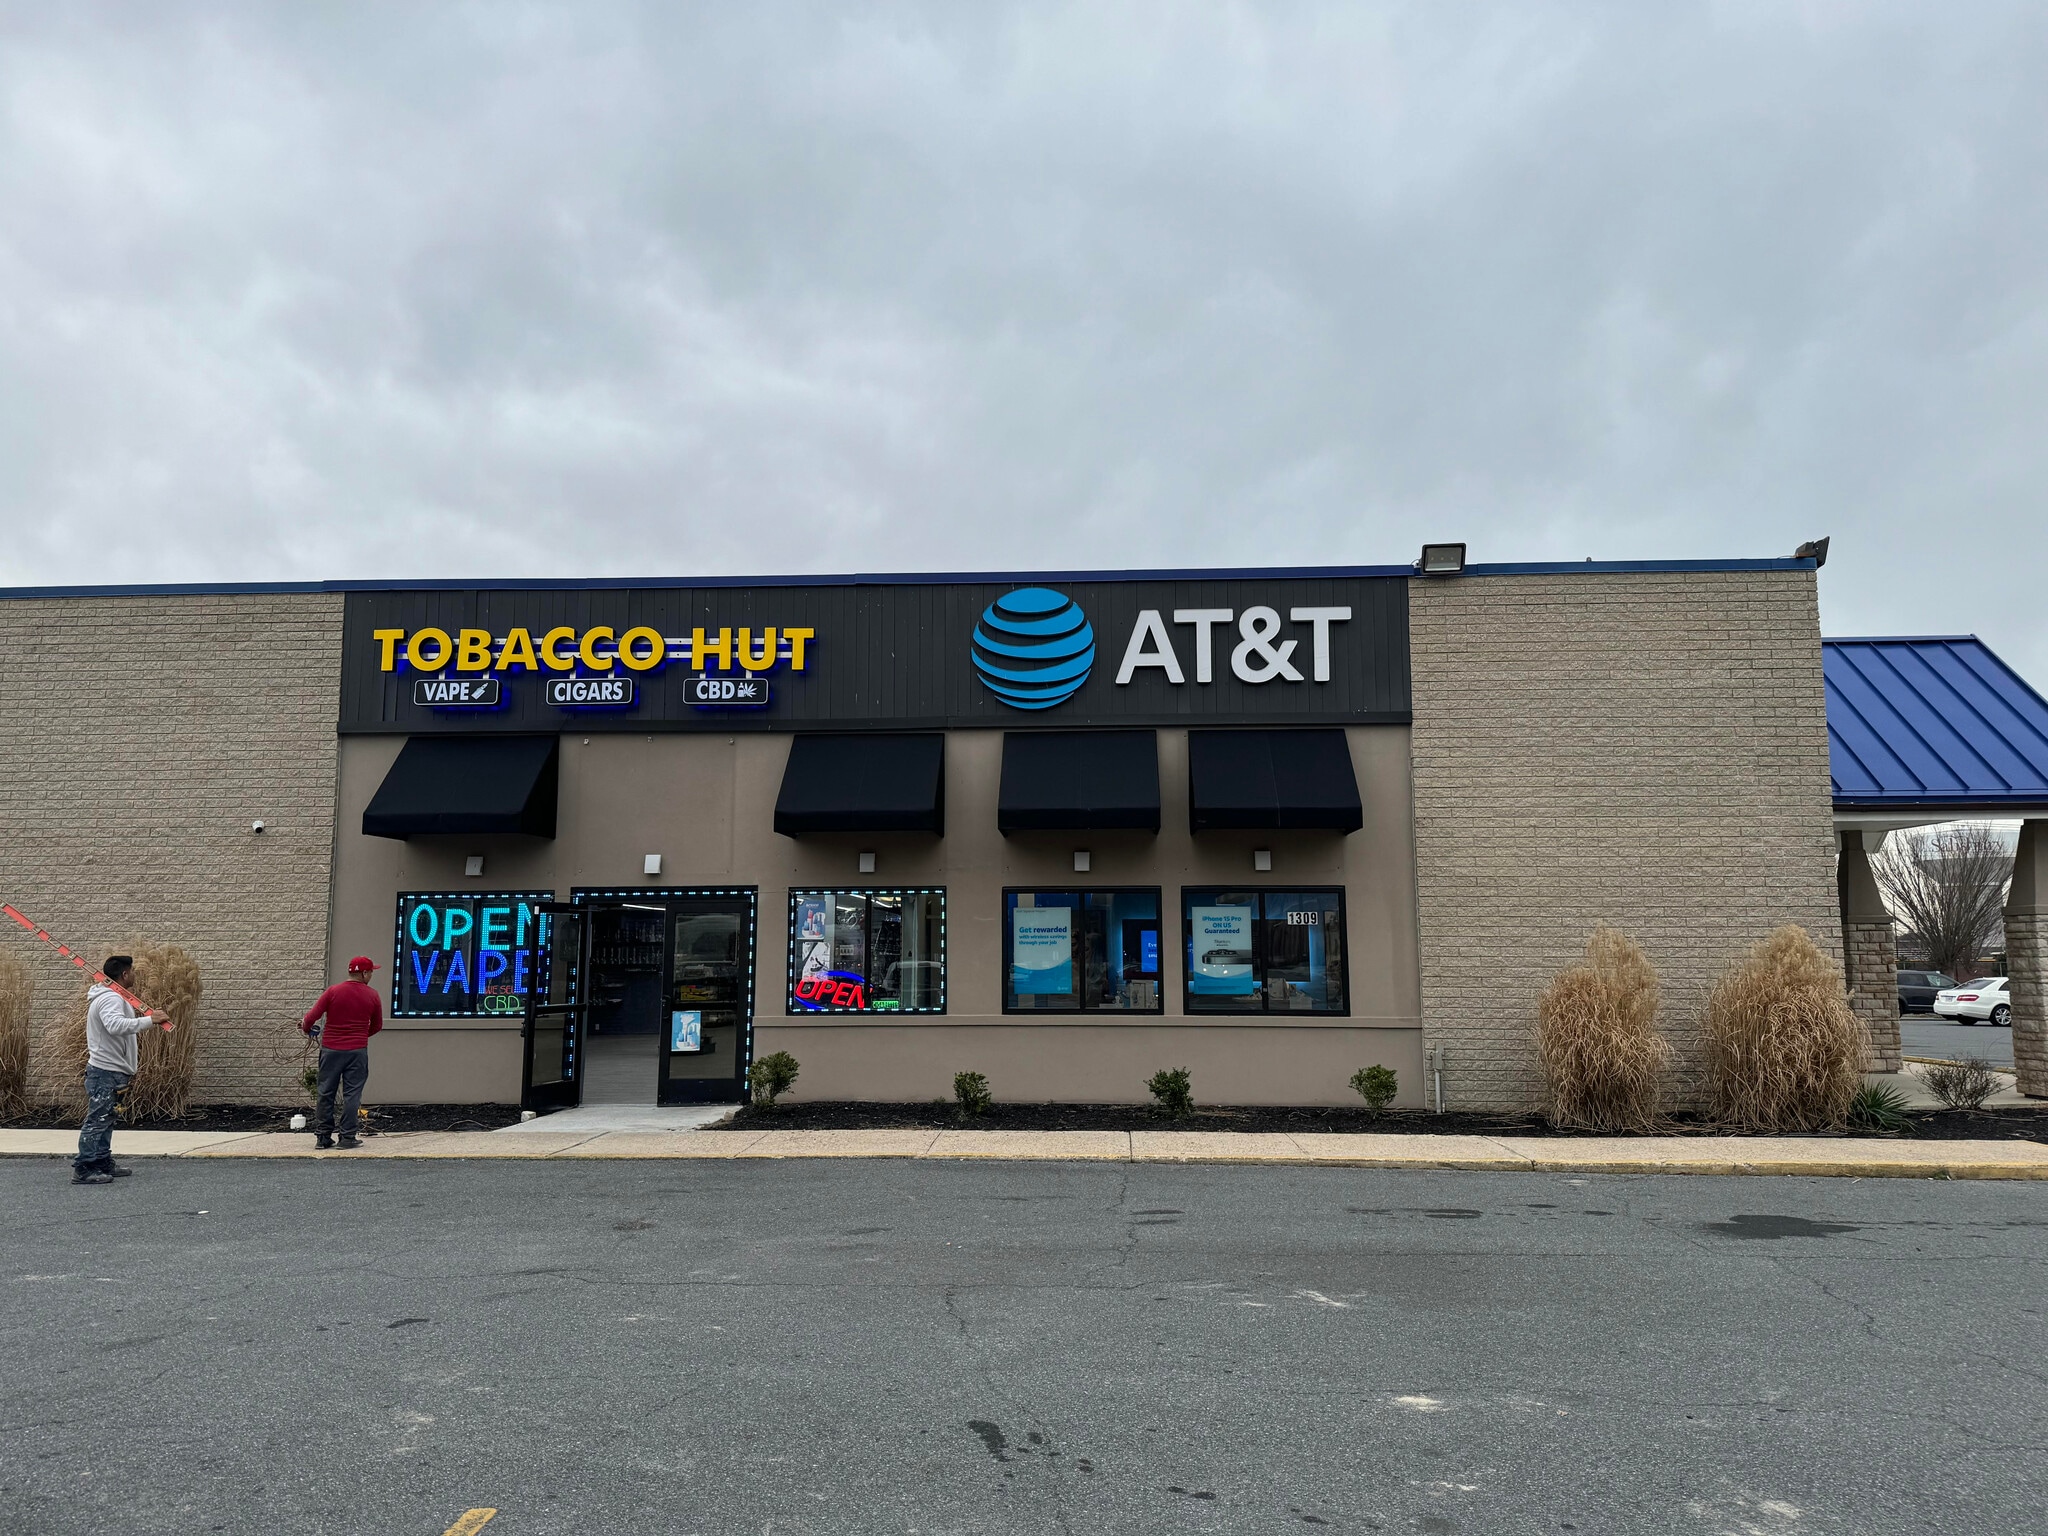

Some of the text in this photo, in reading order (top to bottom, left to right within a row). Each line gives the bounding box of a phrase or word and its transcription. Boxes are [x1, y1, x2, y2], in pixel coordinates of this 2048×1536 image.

[373, 626, 815, 672] TOBACCO HUT
[1115, 605, 1352, 684] AT&T
[423, 682, 470, 701] VAPE
[553, 682, 623, 701] CIGARS
[696, 680, 735, 700] CBD
[410, 903, 547, 950] OPEN
[1288, 912, 1317, 925] 1309
[411, 950, 544, 994] VAPE
[484, 985, 499, 995] WE
[795, 977, 874, 1009] OPEN
[483, 995, 520, 1011] CBD
